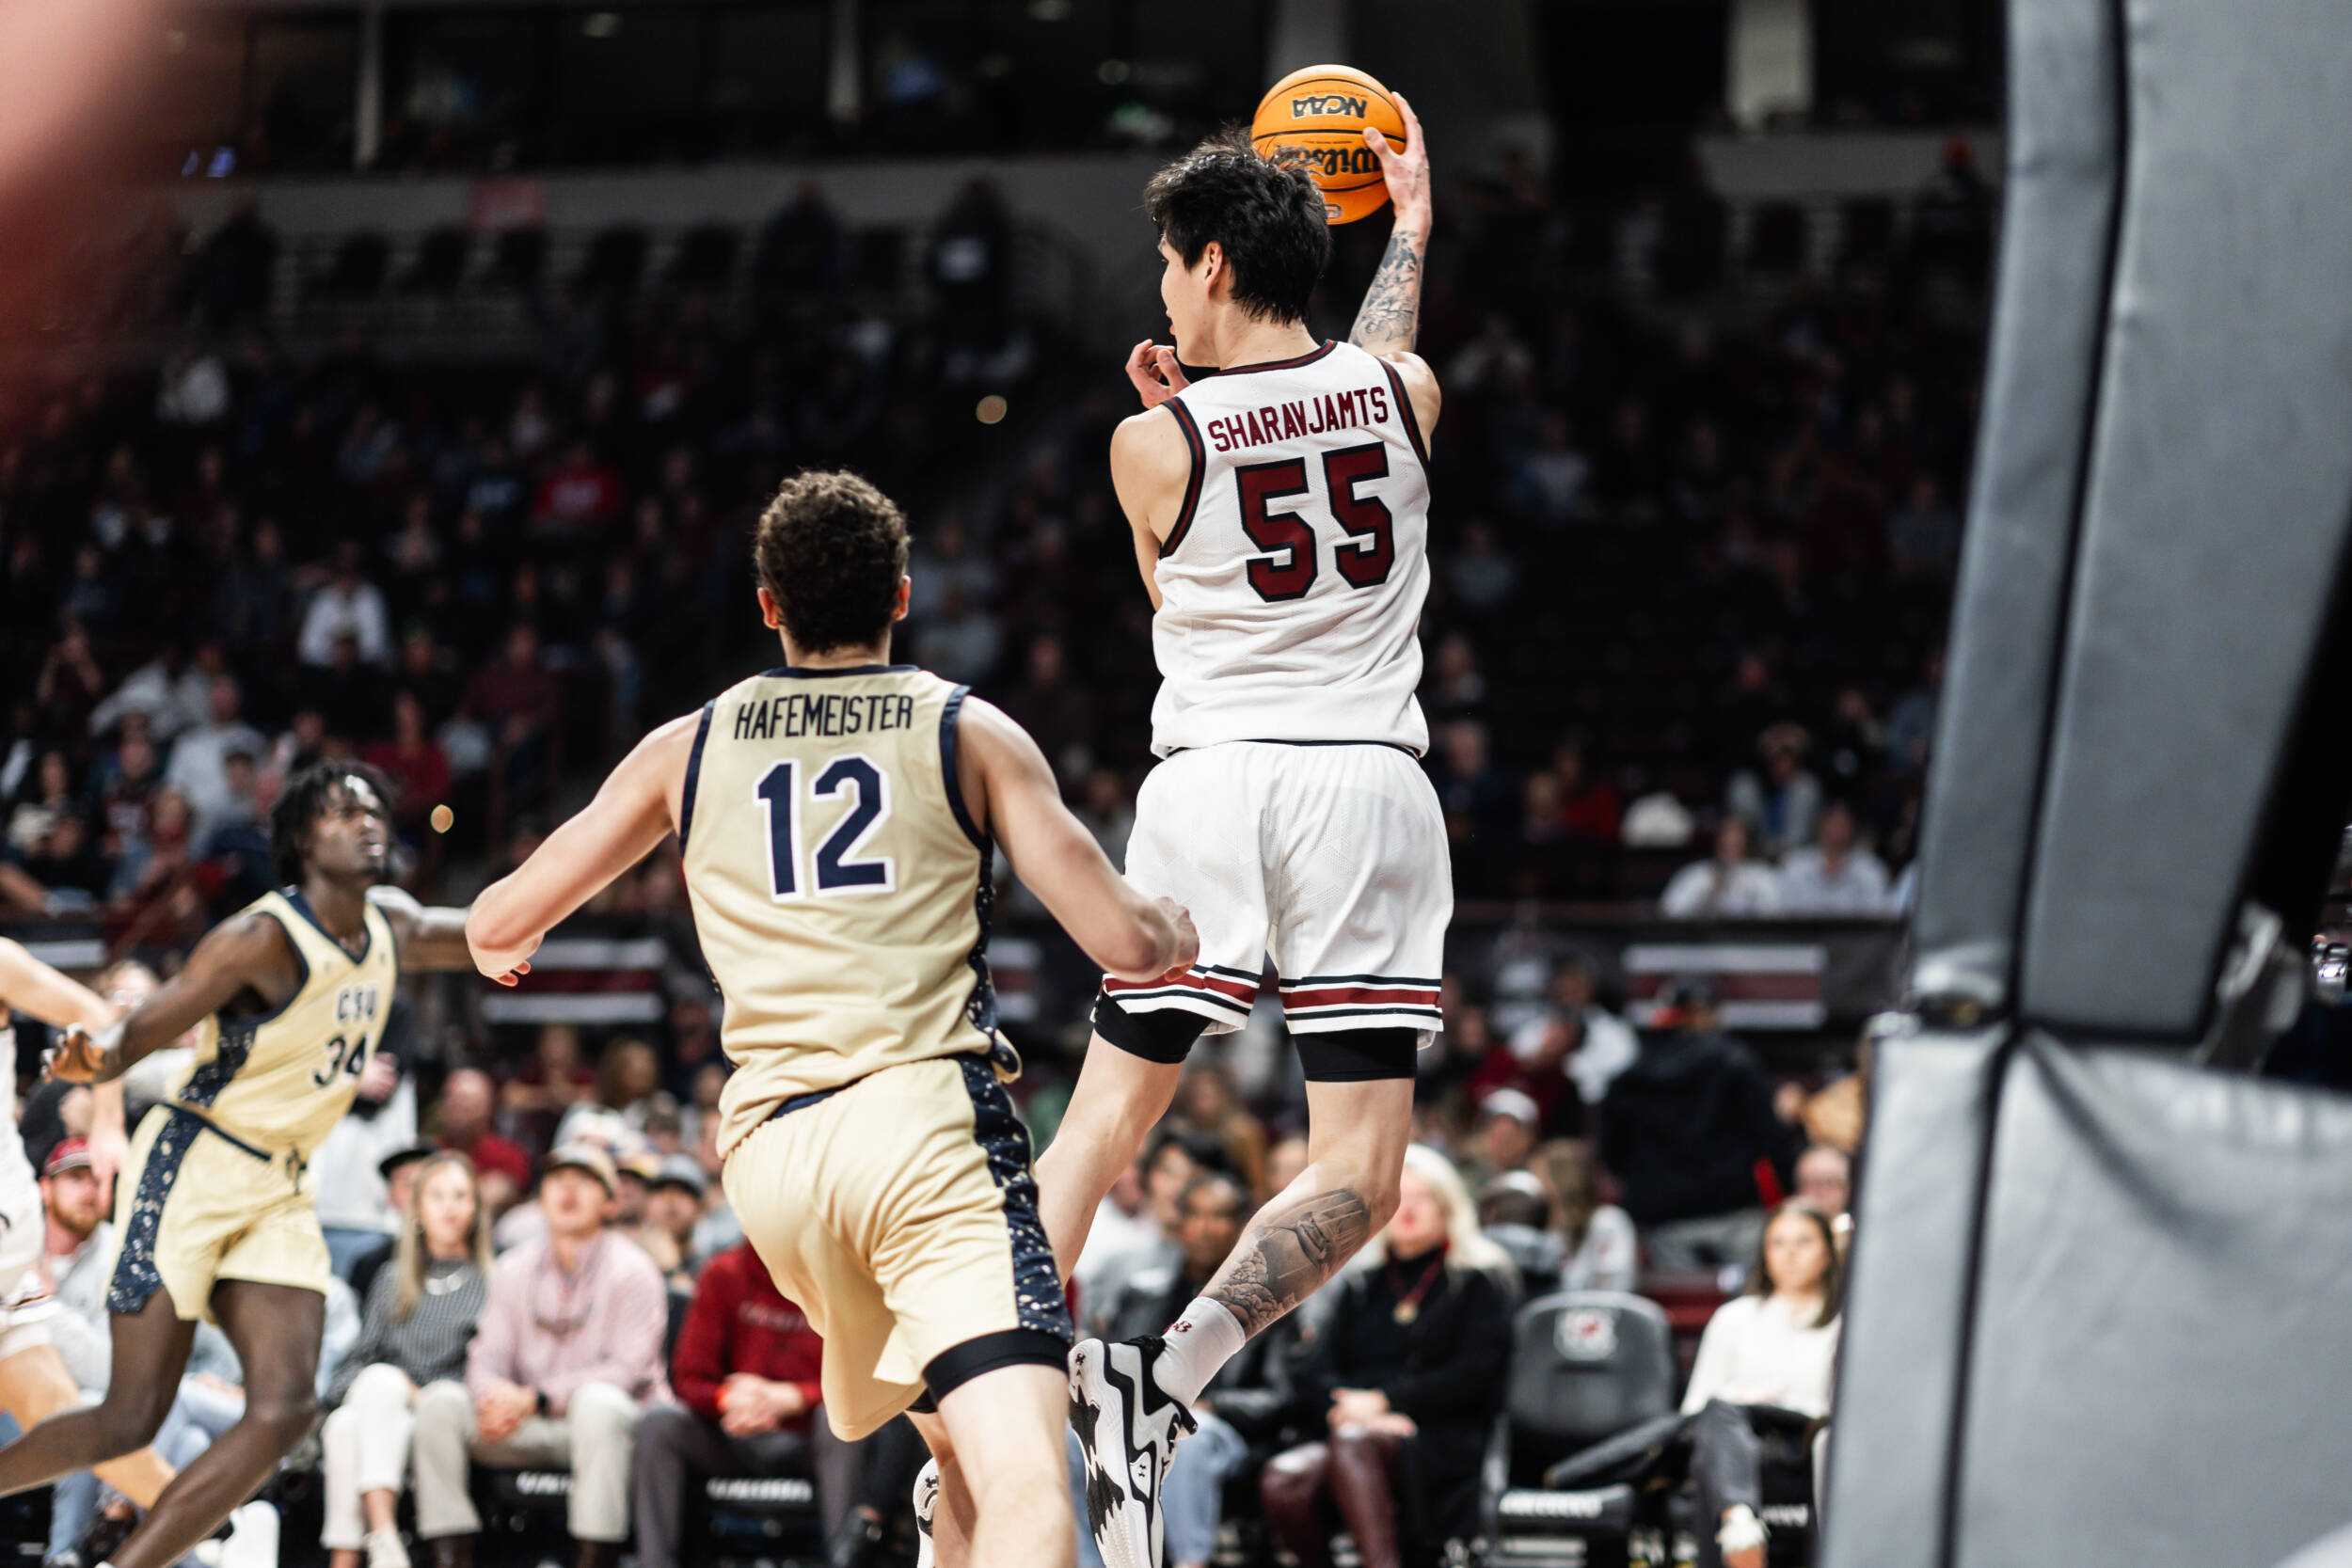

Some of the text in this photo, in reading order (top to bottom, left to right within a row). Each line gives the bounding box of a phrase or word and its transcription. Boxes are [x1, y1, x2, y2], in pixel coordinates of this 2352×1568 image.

[1292, 95, 1367, 119] NCAA
[1207, 386, 1389, 452] SHARAVJAMTS
[1234, 441, 1395, 603] 55
[734, 693, 914, 740] HAFEMEISTER
[754, 754, 895, 901] 12
[338, 987, 377, 1022] CSU
[313, 1034, 368, 1086] 34
